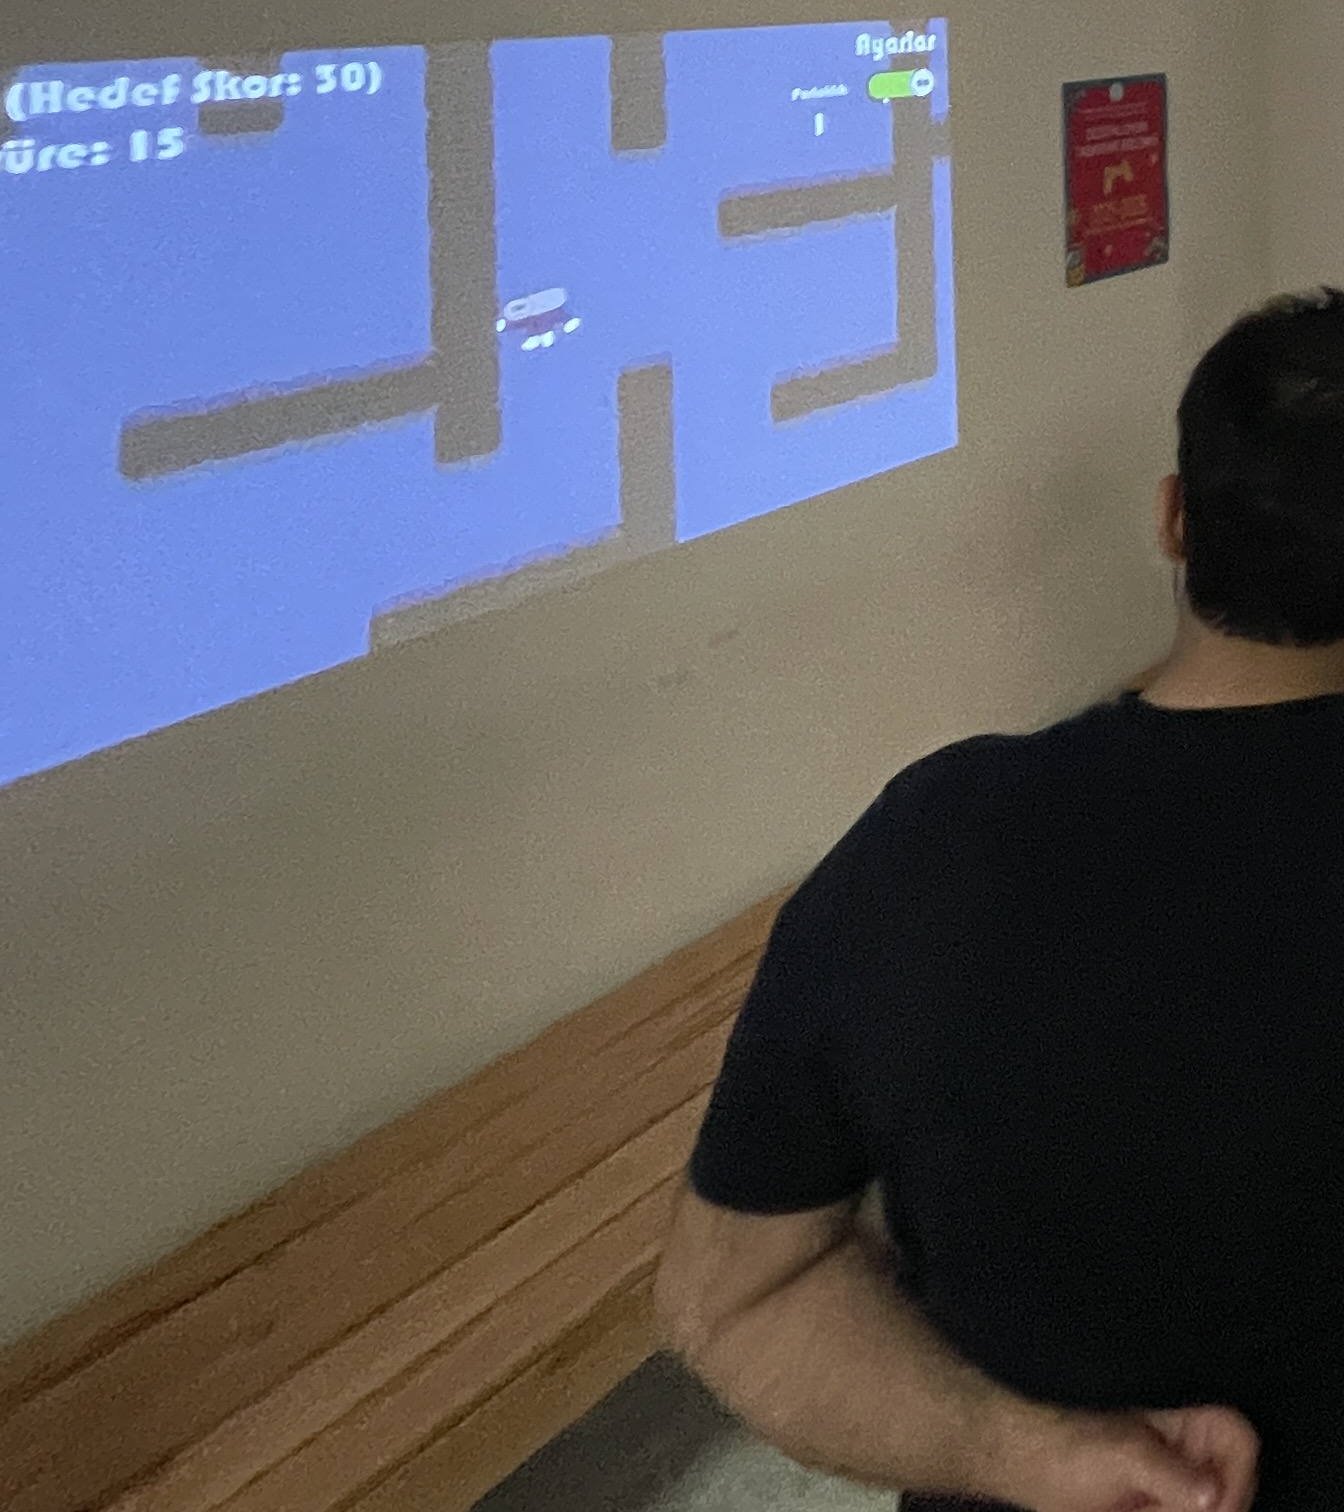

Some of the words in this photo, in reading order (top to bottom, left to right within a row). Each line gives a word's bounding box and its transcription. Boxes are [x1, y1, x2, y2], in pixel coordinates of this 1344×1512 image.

[855, 30, 937, 62] Ayarlar
[5, 73, 182, 122] (Hedef
[190, 70, 303, 104] Skor:
[315, 61, 383, 95] 30)
[0, 137, 111, 175] üre:
[129, 126, 186, 163] 15
